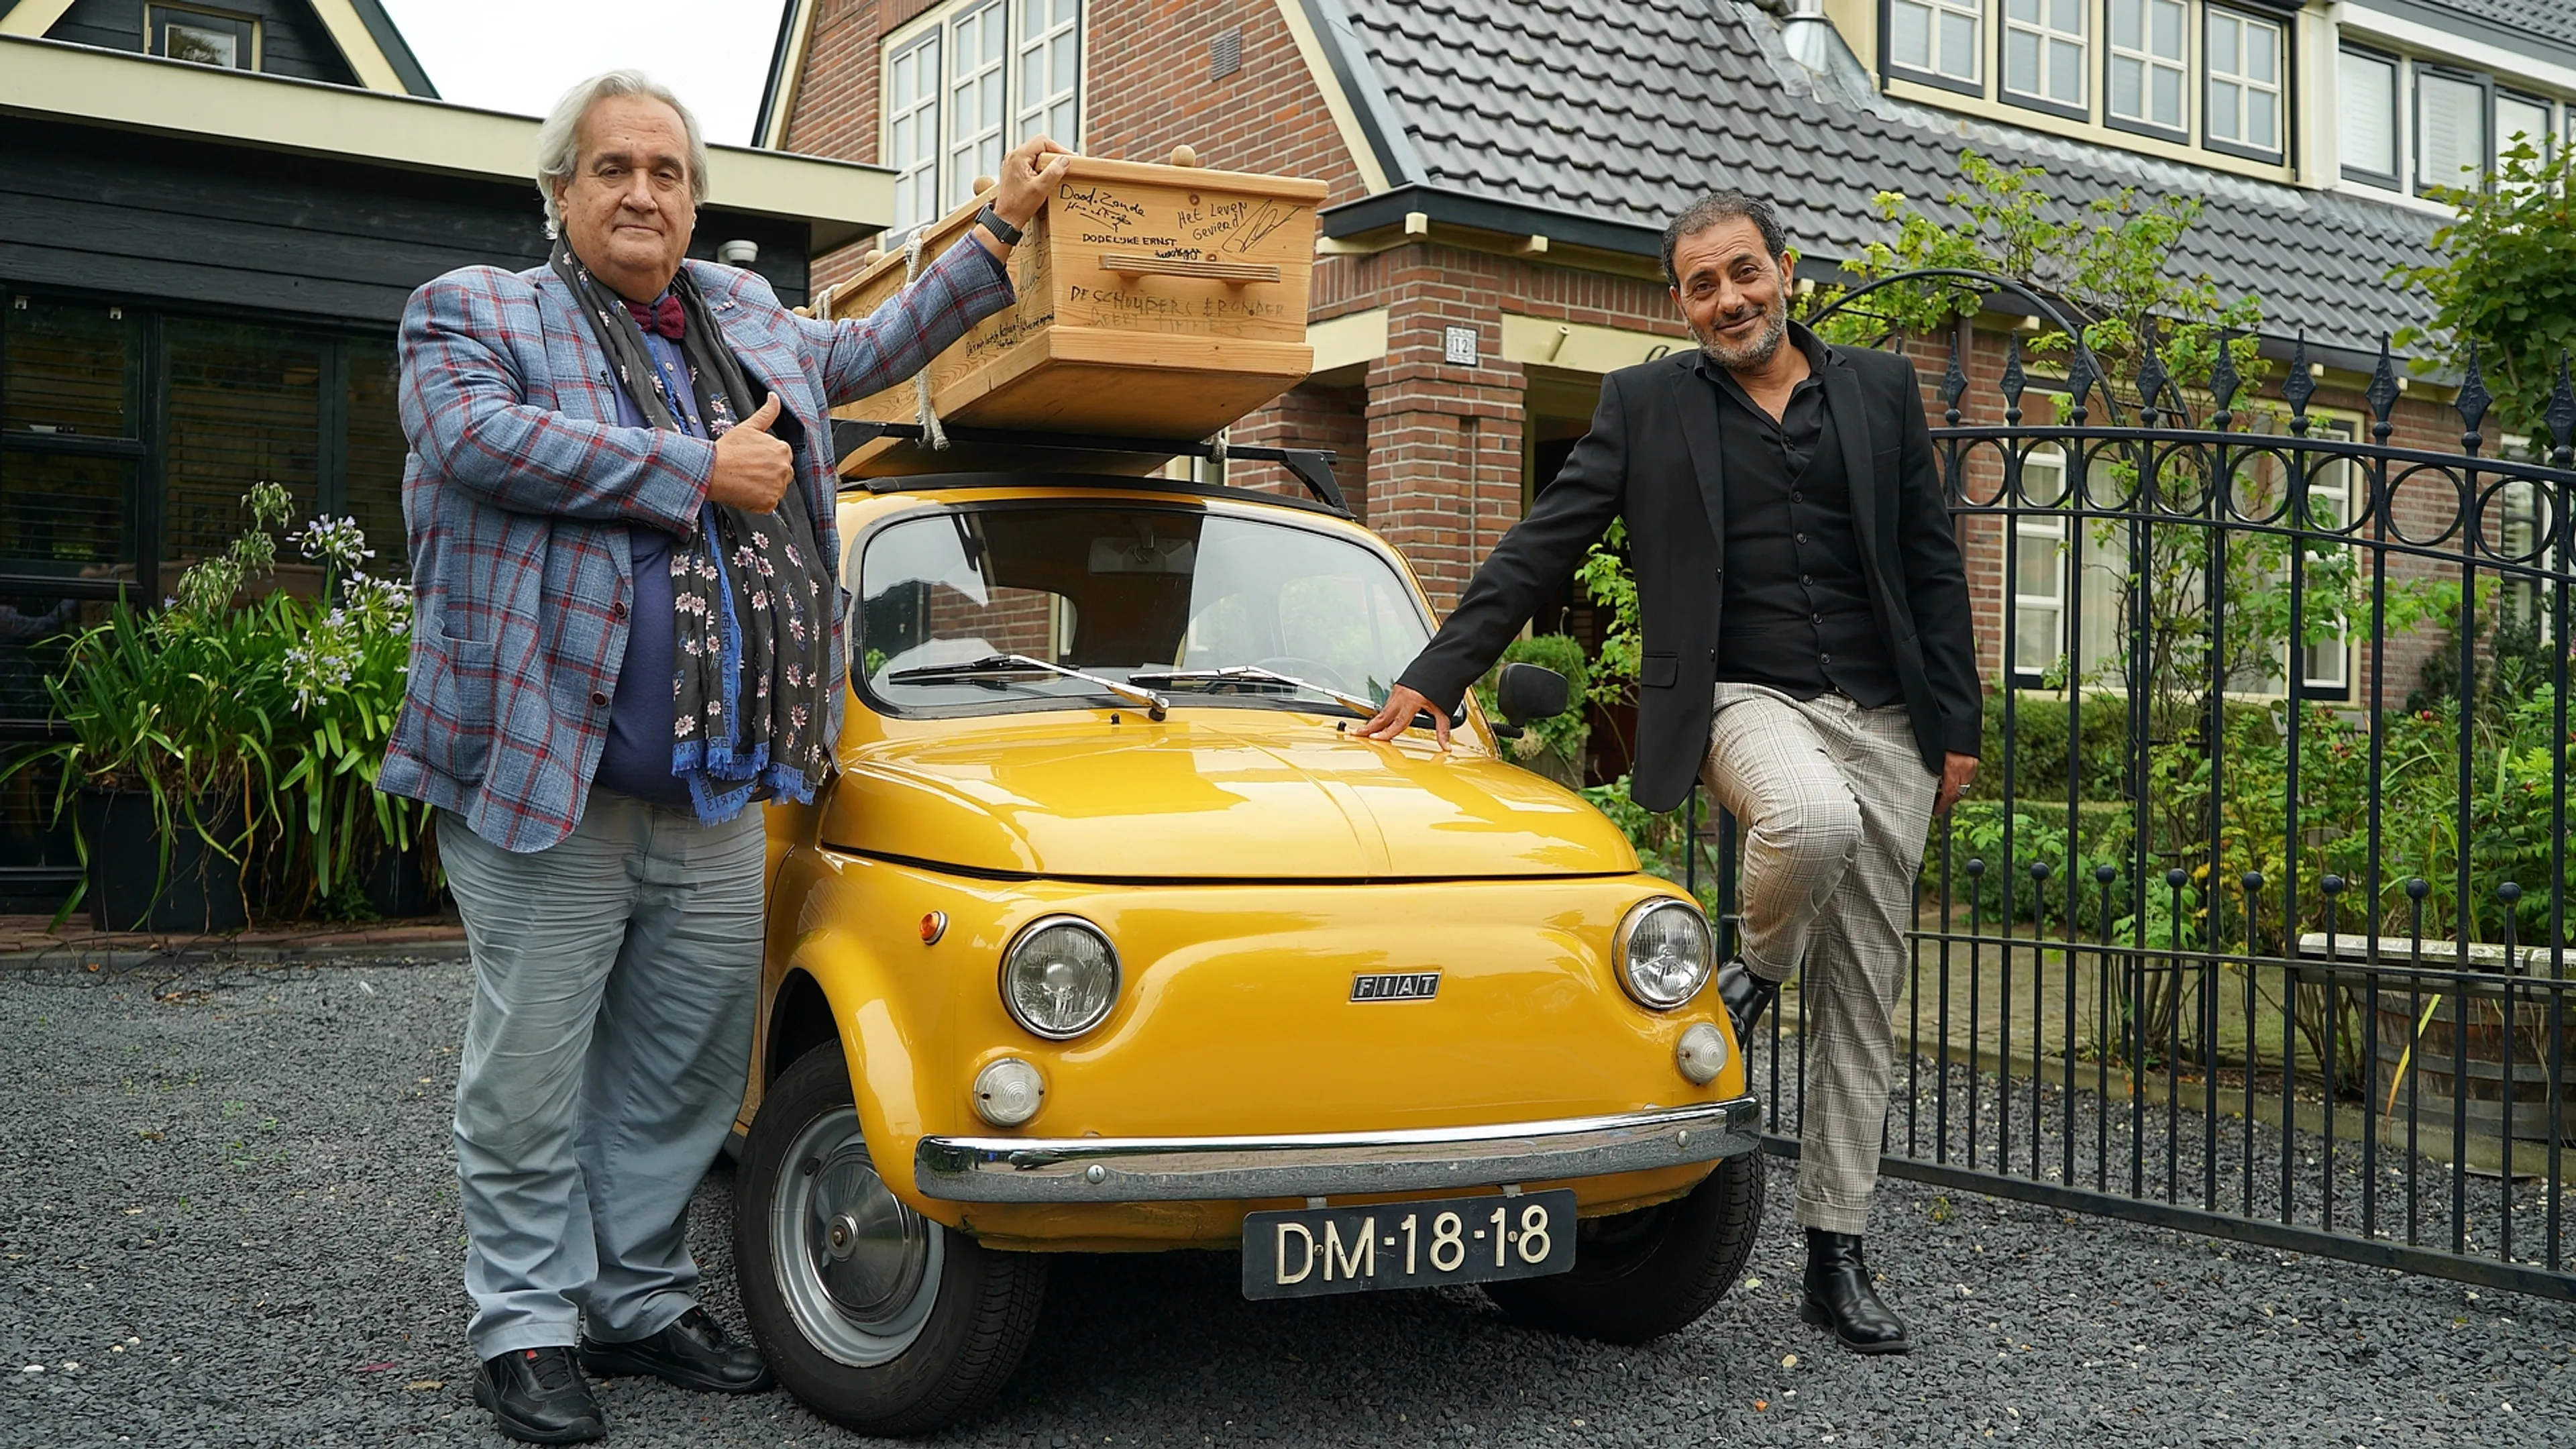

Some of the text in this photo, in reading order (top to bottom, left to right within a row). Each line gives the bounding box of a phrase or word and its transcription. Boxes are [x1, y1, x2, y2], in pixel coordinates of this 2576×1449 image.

[1177, 208, 1203, 229] Het
[1142, 237, 1178, 247] ERNST
[1071, 286, 1089, 302] DE
[1454, 337, 1468, 354] 12
[1356, 975, 1438, 999] FIAT
[1276, 1204, 1551, 1285] DM-18-18
